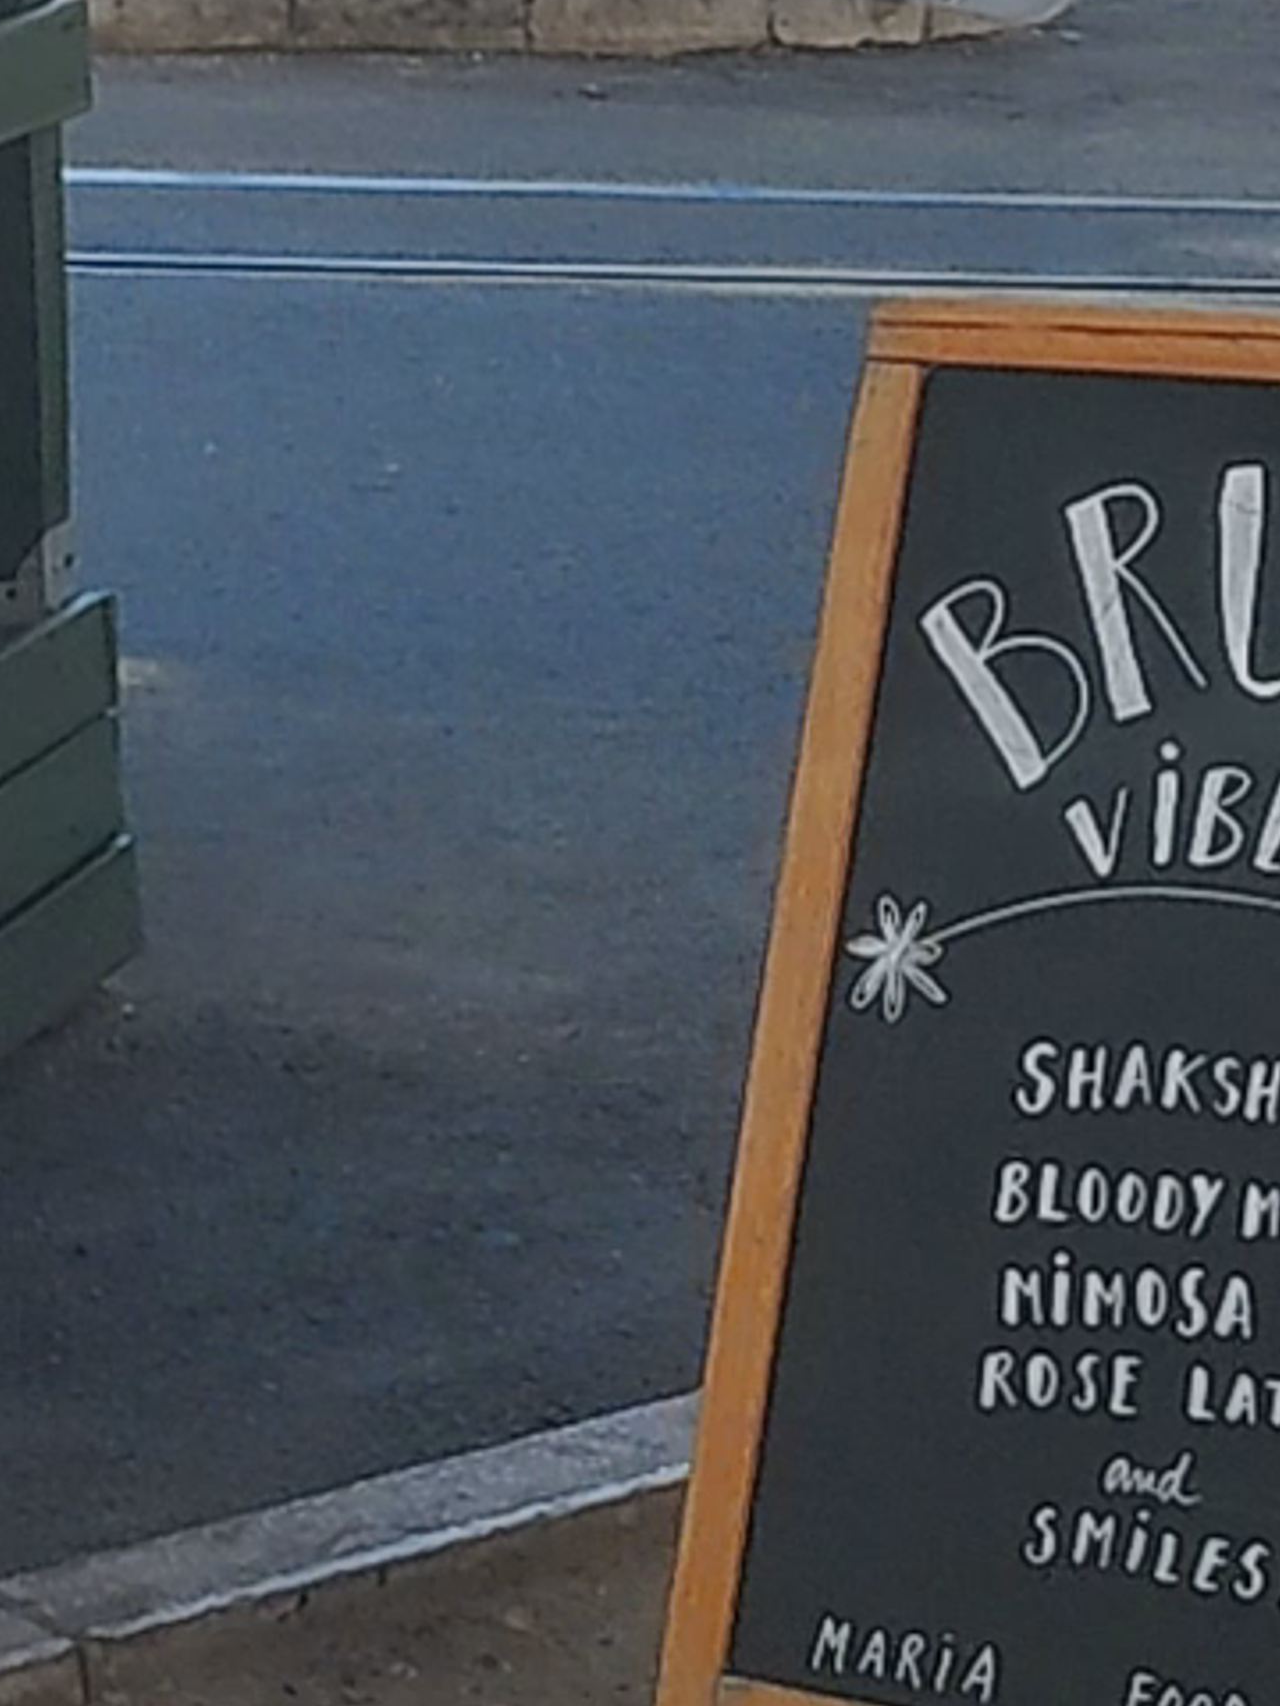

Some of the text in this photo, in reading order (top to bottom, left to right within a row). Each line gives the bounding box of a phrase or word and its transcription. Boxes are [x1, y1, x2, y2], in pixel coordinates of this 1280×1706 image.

[995, 1160, 1223, 1236] BLOODY
[979, 1351, 1141, 1416] ROSE
[1104, 1454, 1198, 1505] and
